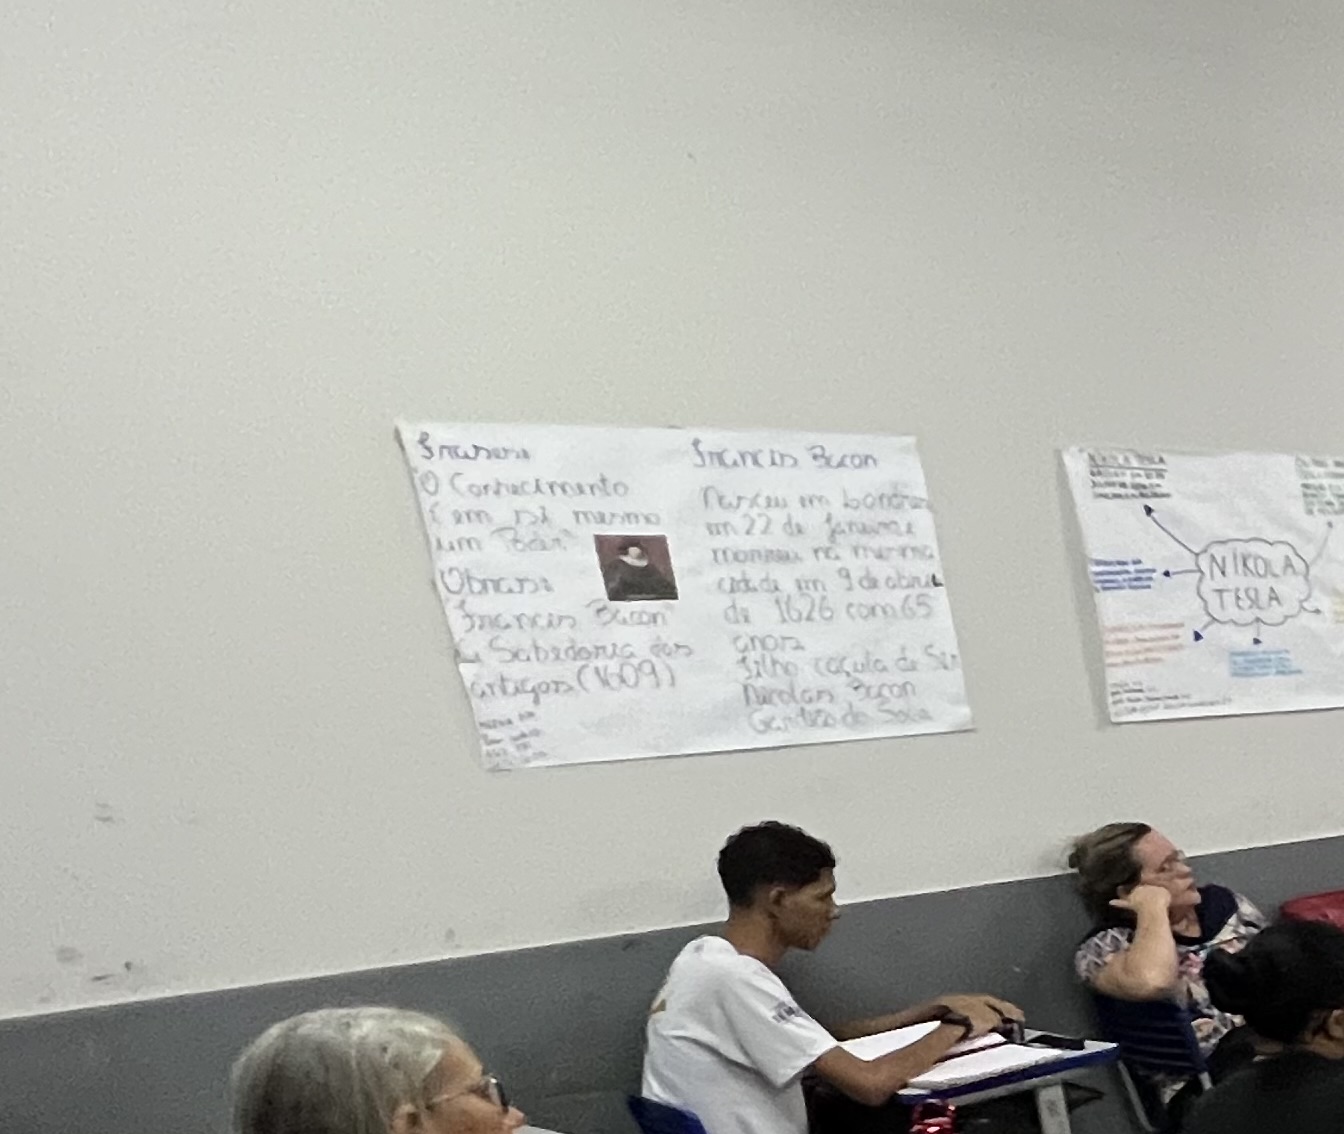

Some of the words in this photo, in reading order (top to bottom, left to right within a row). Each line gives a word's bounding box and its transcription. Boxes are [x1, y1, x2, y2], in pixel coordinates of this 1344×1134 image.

[742, 512, 773, 537] 22
[1208, 547, 1298, 581] NIKOLA
[837, 566, 854, 592] 9
[774, 592, 834, 624] 1626
[899, 592, 936, 622] 65
[1211, 585, 1283, 612] TESLA
